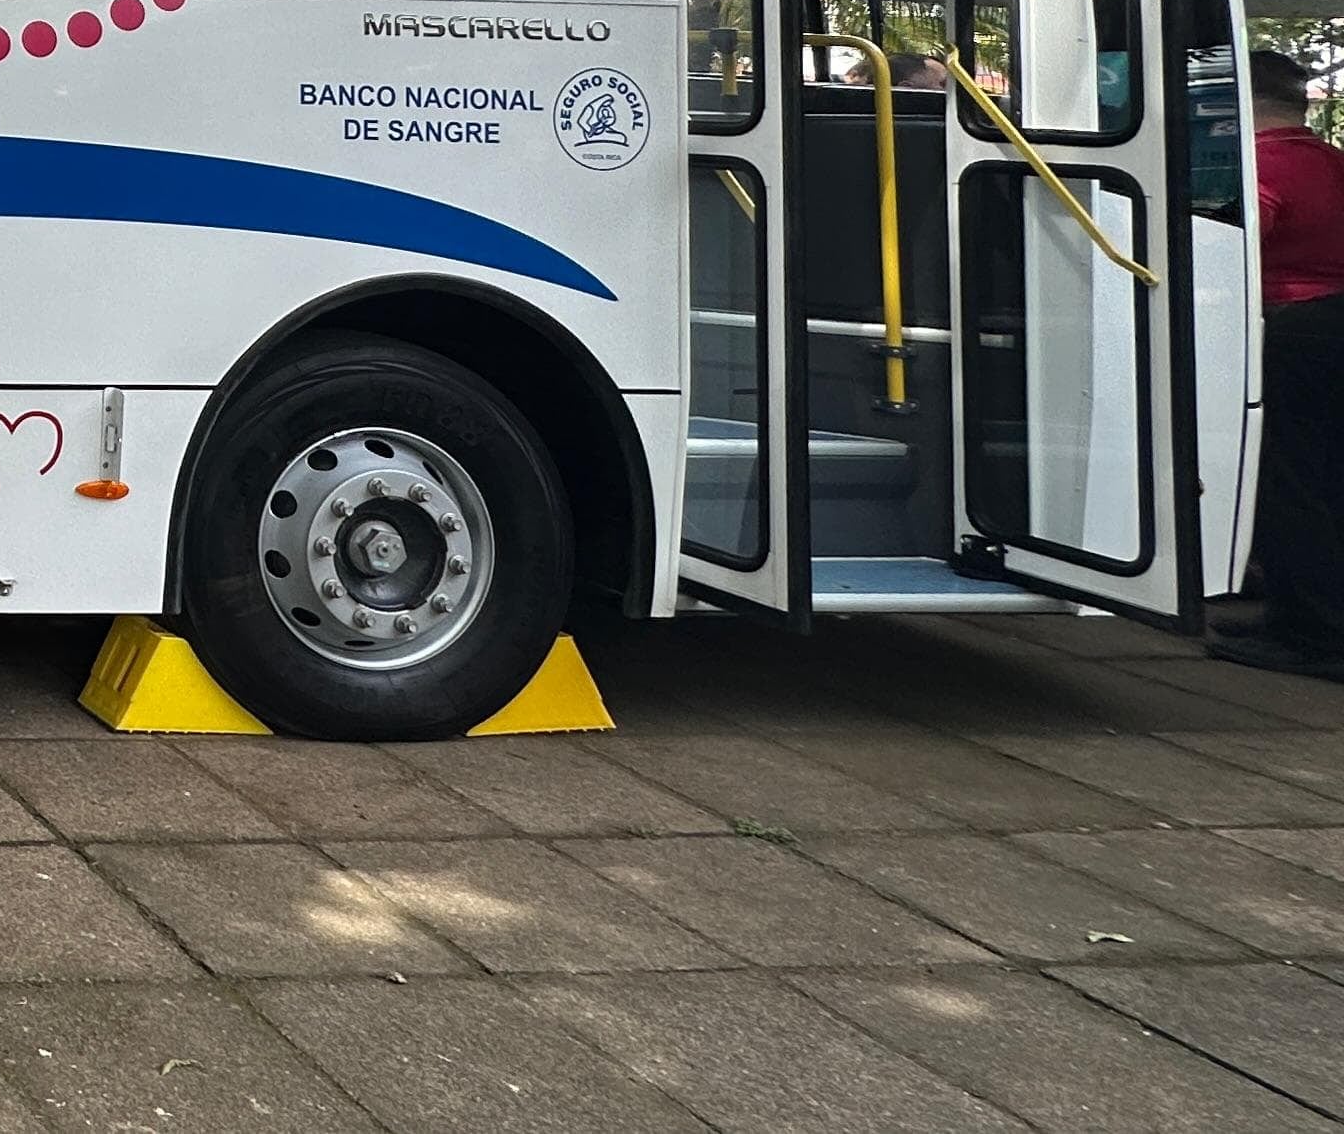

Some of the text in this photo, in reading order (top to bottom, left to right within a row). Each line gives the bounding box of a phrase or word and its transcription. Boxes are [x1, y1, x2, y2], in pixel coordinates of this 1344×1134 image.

[364, 13, 611, 42] MASCARELLO
[299, 83, 544, 111] BANCO NACIONAL
[560, 75, 644, 131] SEGURO SOCIAL
[344, 119, 500, 144] DE SANGRE
